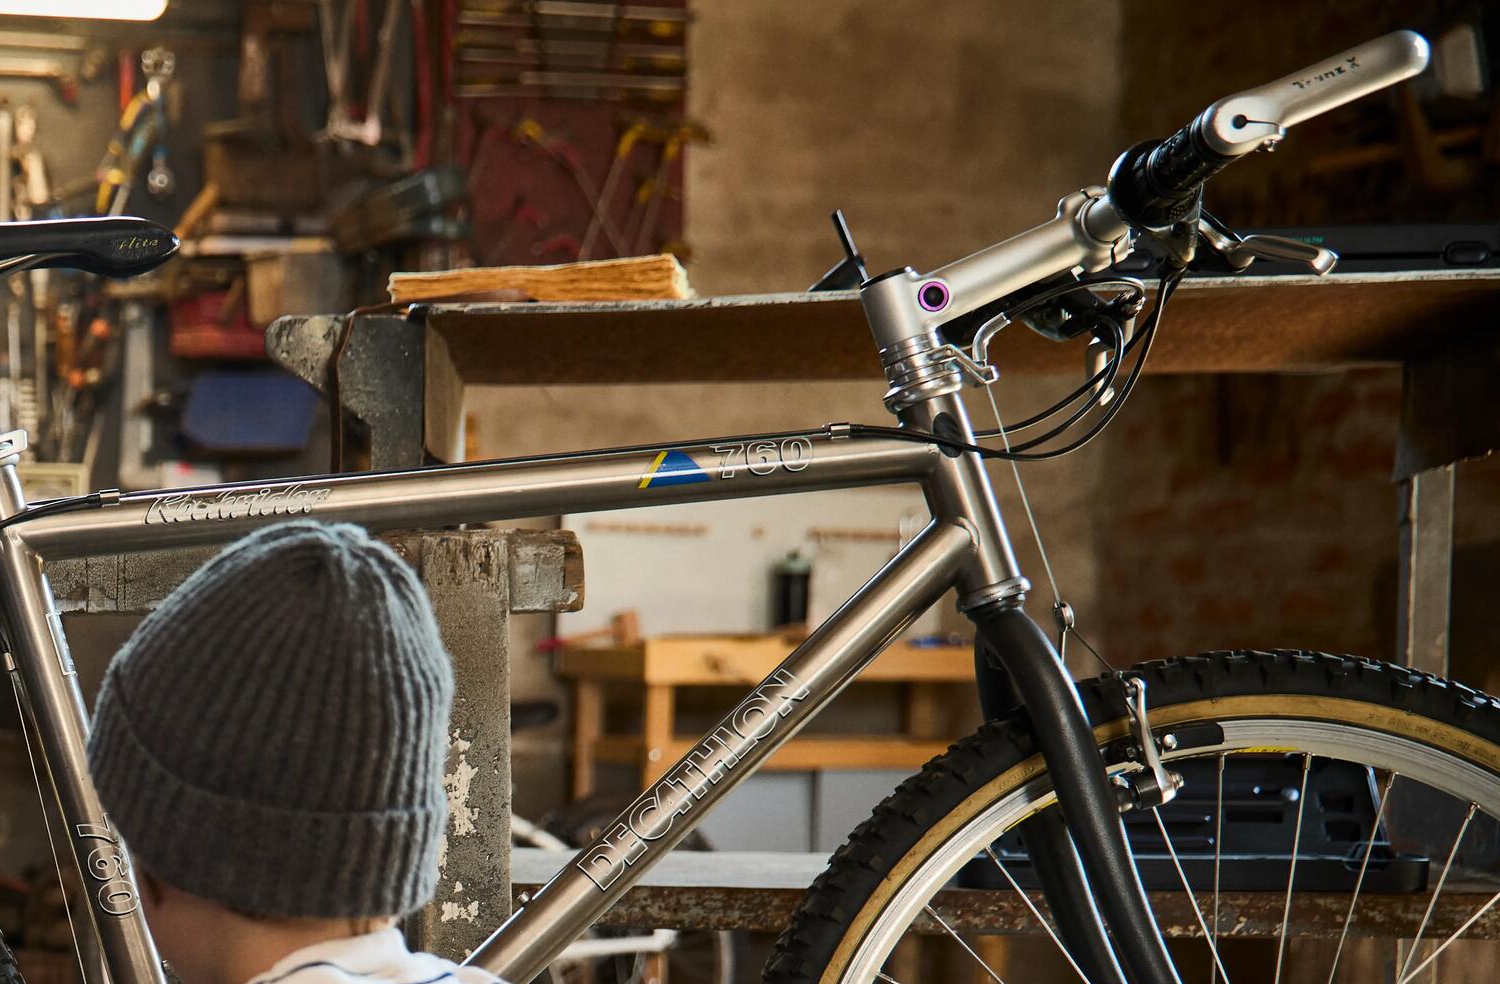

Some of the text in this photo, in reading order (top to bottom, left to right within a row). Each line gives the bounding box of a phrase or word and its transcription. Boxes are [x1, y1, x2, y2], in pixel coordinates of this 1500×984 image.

[709, 436, 815, 480] 760
[577, 668, 810, 891] DECATHLON
[76, 811, 140, 915] 760
